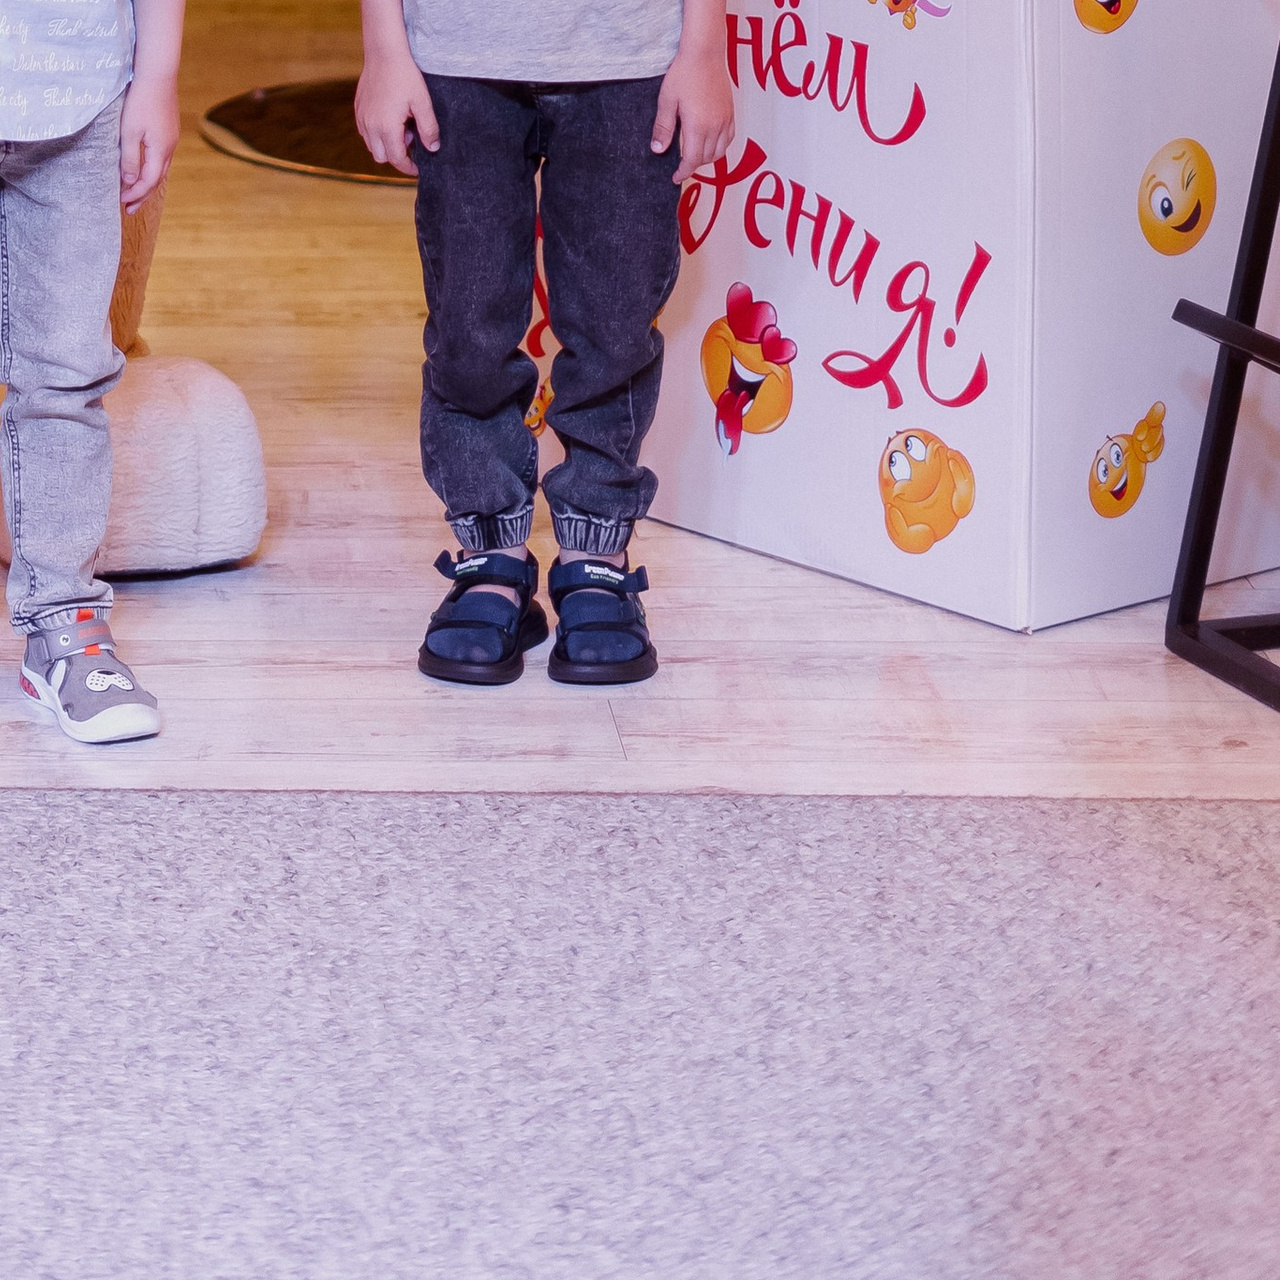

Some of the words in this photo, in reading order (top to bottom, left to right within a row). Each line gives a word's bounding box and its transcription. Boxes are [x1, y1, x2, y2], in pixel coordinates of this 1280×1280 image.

[47, 18, 83, 36] Think
[44, 52, 60, 71] the
[9, 90, 28, 116] city
[43, 87, 72, 107] Think
